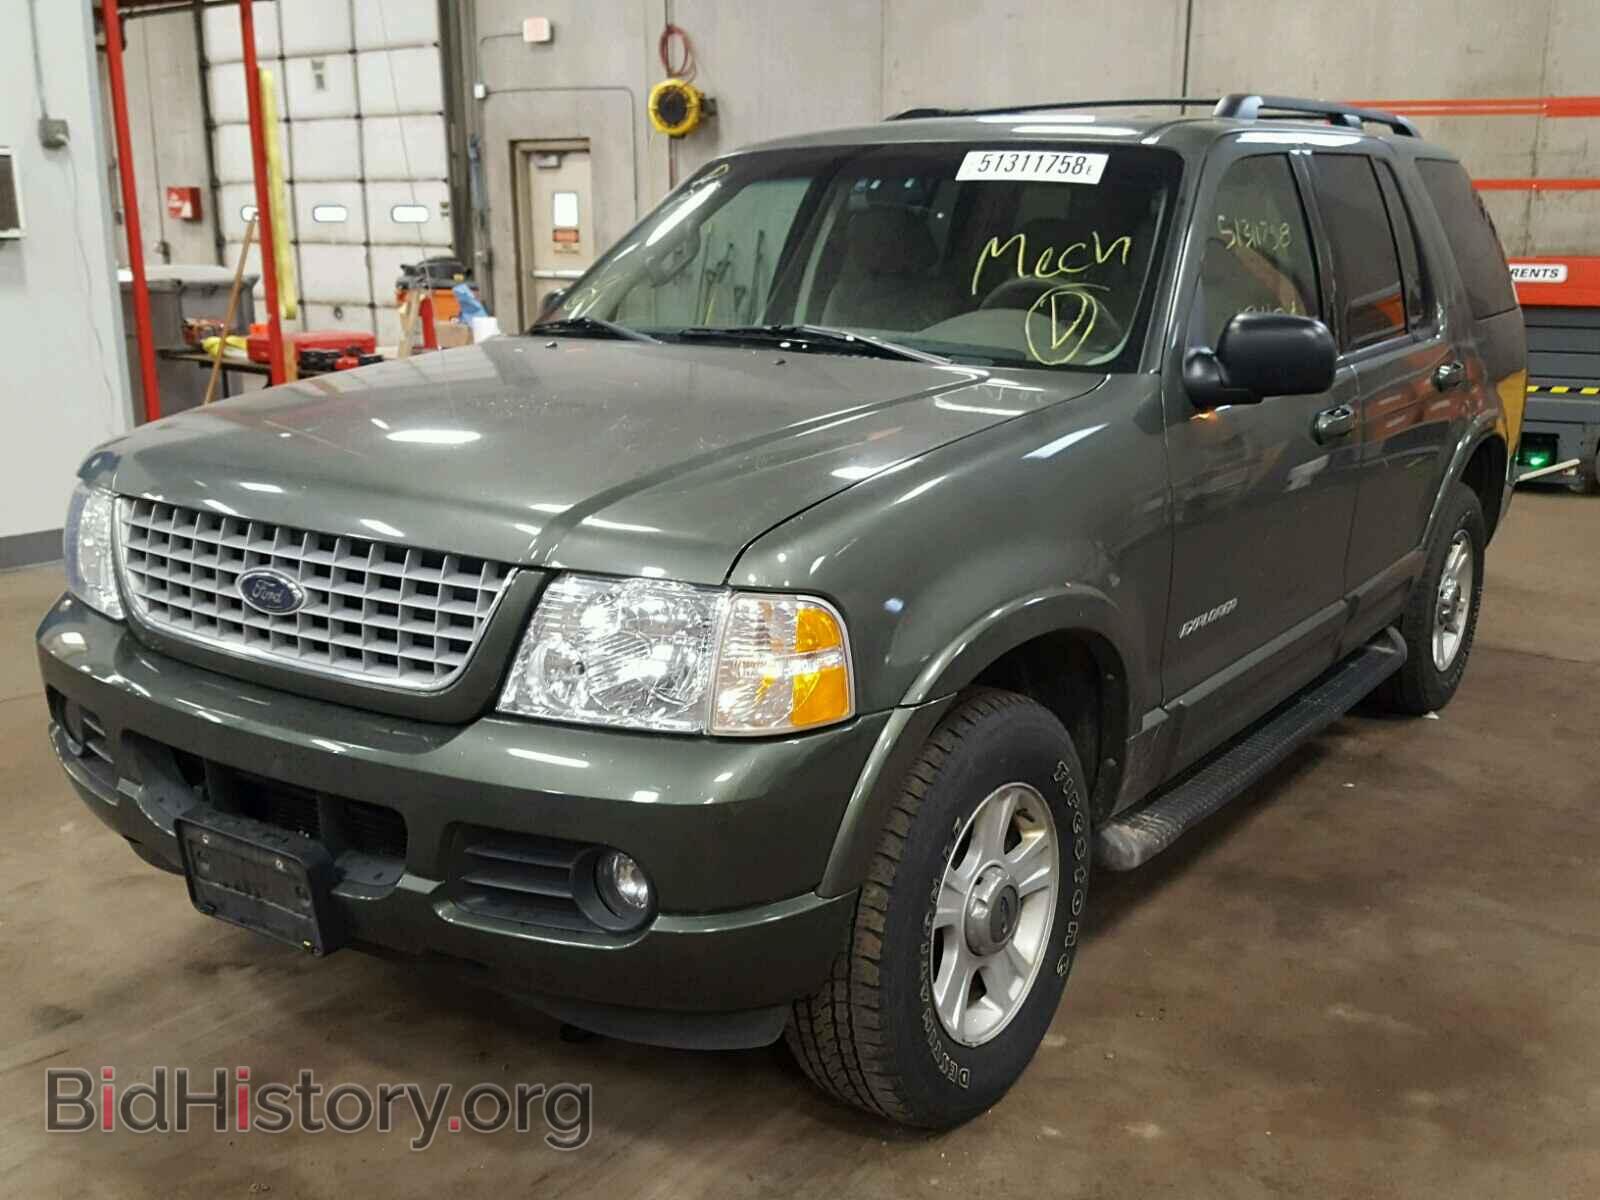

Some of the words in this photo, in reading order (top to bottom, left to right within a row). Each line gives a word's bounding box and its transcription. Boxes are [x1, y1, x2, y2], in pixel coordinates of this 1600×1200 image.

[972, 230, 1132, 295] Mech
[1511, 267, 1560, 279] RENTS
[252, 579, 289, 604] Ford
[1179, 597, 1238, 640] EXPLORER
